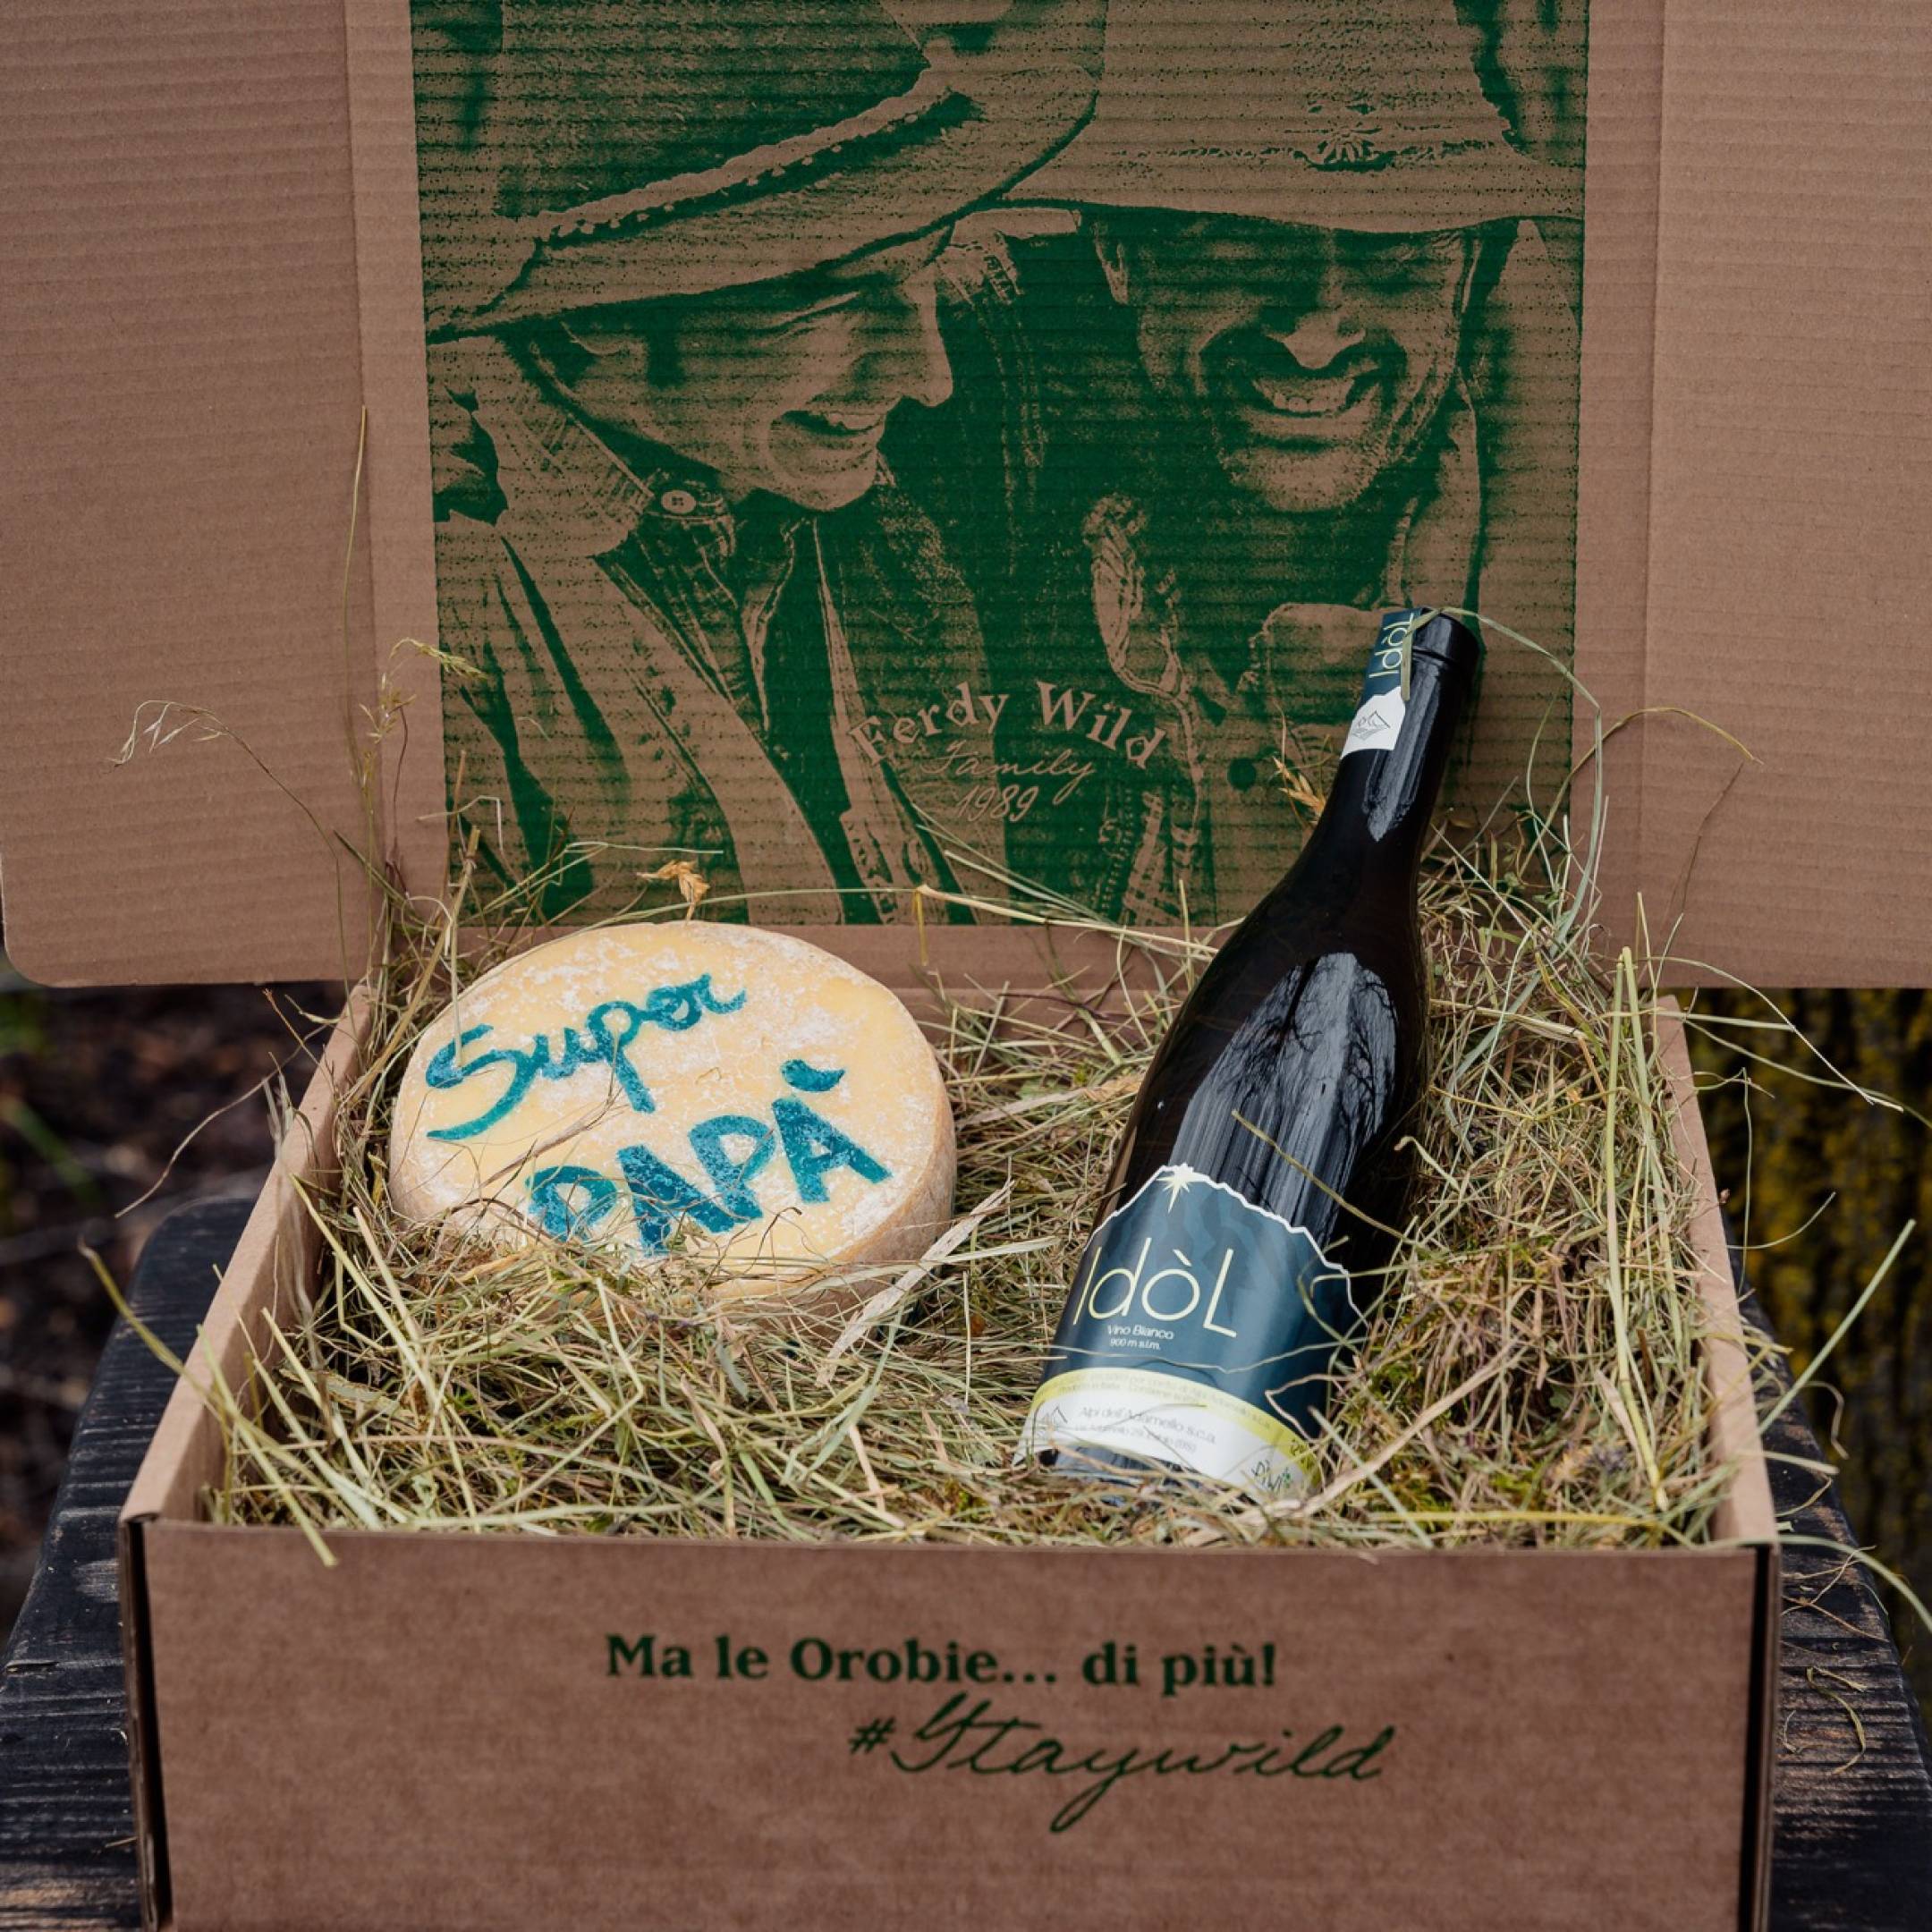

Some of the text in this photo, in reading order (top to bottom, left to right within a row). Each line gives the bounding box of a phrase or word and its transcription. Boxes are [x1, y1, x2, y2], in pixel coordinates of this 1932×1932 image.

[847, 681, 1166, 769] Ferdy Wild
[921, 739, 1097, 805] Family
[955, 784, 1039, 822] 1989
[425, 973, 747, 1140] Super
[526, 1059, 892, 1257] PAPÀ
[1073, 1237, 1237, 1339] IdòL
[1107, 1324, 1175, 1340] Vino Bianco
[606, 1634, 1275, 1698] Ma le Orobie... di più!
